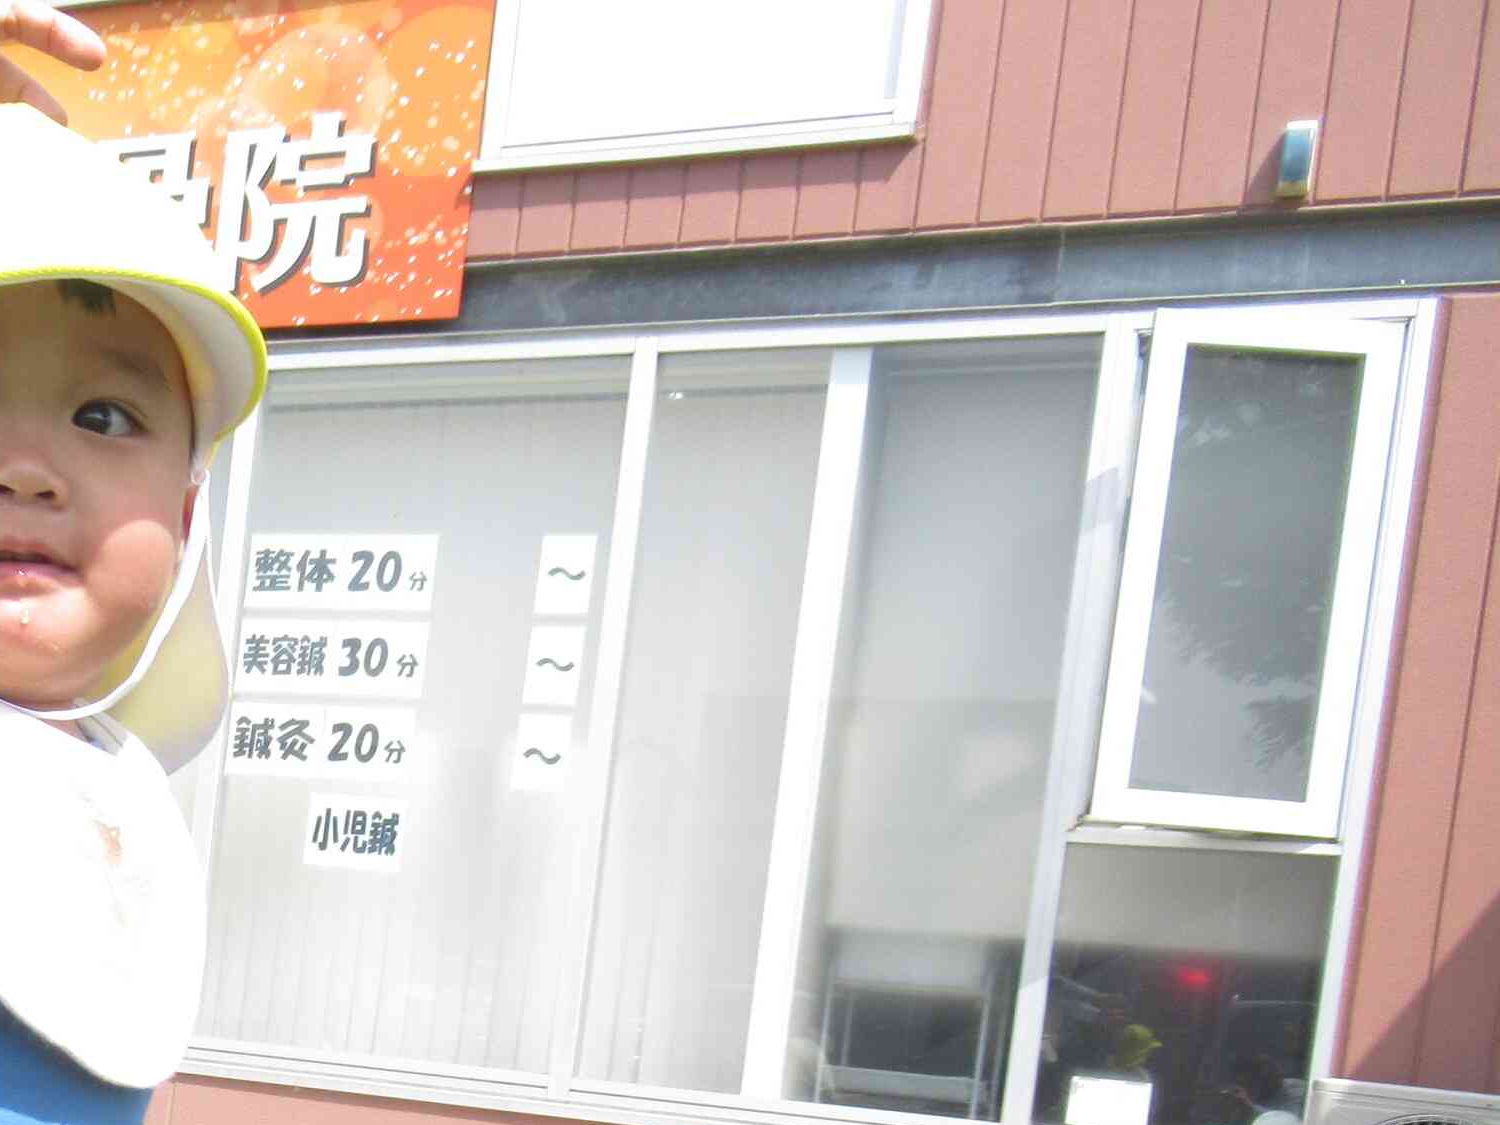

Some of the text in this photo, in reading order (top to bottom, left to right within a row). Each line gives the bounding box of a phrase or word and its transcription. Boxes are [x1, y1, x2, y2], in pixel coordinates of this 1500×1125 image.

[252, 548, 337, 593] 整体
[243, 633, 328, 676] 美容鍼
[232, 716, 316, 761] 鍼灸
[311, 807, 400, 856] 小児鍼
